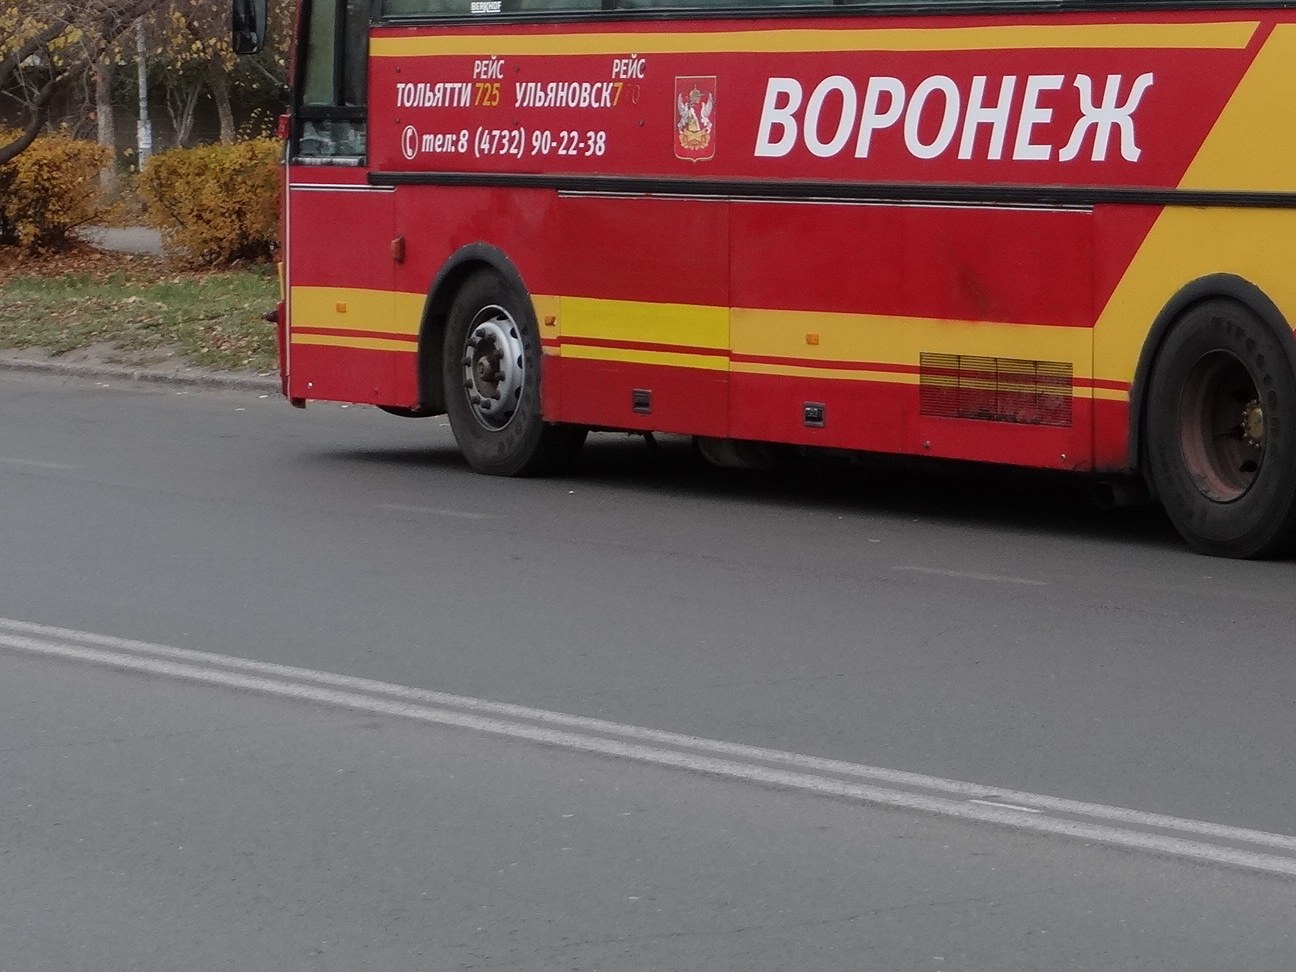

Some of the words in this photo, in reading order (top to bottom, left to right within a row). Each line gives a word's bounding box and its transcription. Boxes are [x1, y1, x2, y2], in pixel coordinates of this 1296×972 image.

[470, 1, 502, 13] BERKHOF
[473, 55, 505, 79] РЕЙС
[612, 53, 646, 79] РЕЙС
[396, 83, 472, 107] ТОЛЬЯТТИ
[474, 83, 500, 106] 725
[754, 72, 1154, 163] ВОРОНЕЖ
[474, 127, 525, 159] (4732)
[531, 131, 607, 156] 90-22-38
